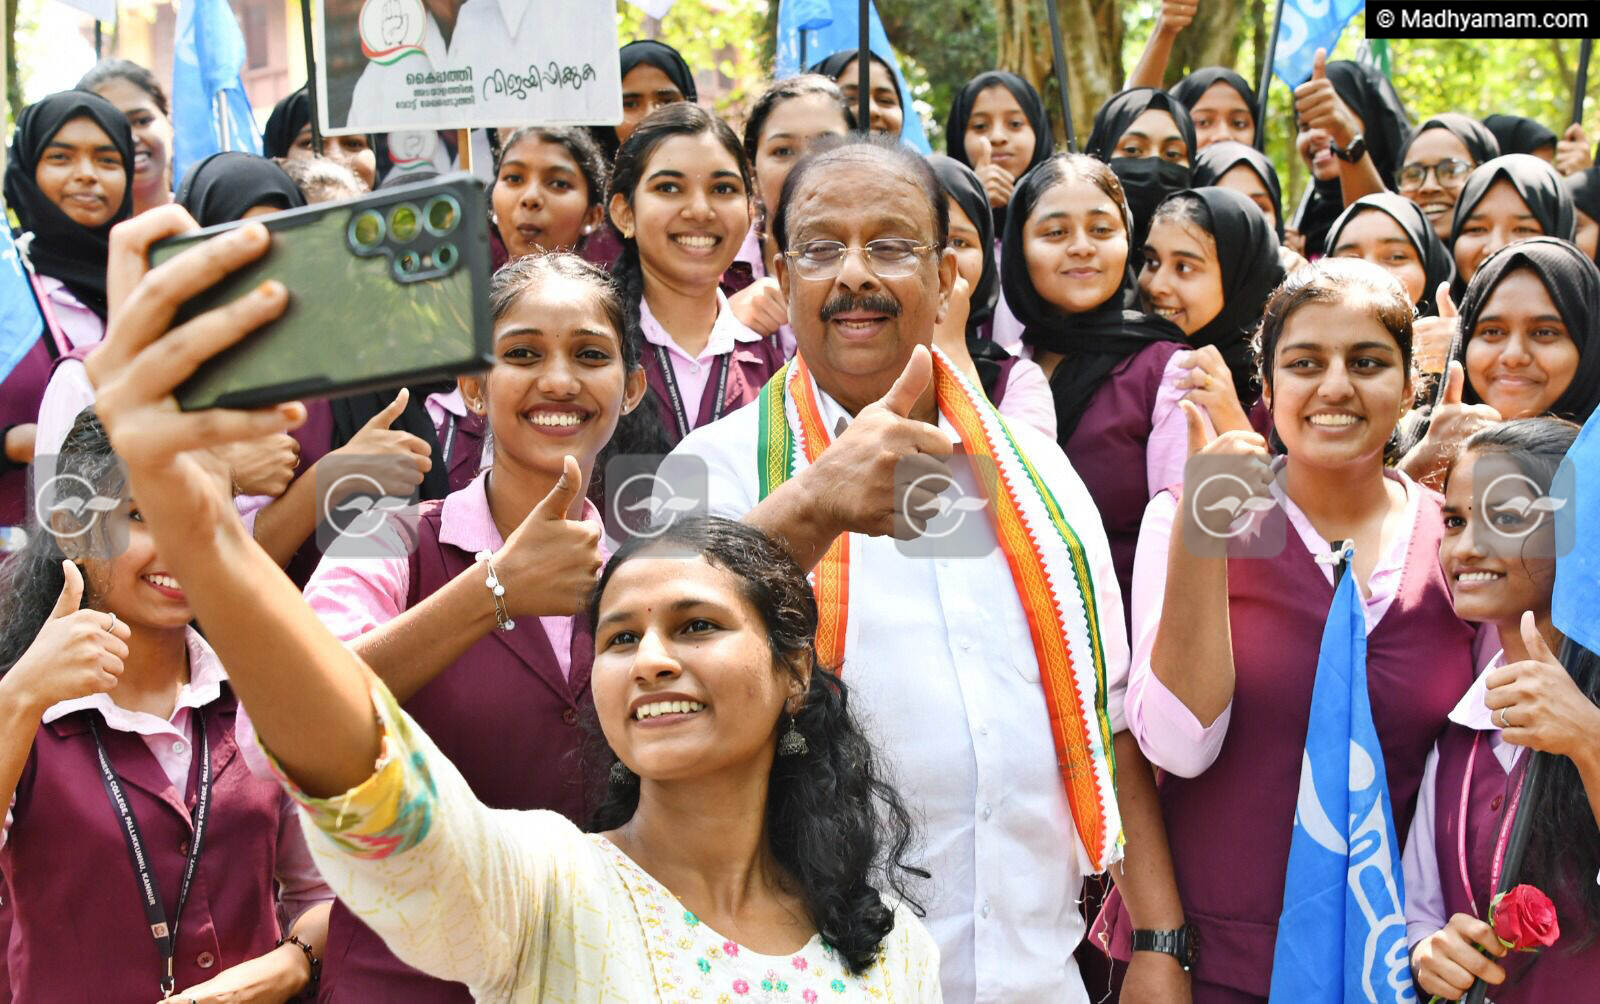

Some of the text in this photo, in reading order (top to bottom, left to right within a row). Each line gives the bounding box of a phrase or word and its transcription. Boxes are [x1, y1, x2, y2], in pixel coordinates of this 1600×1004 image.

[406, 66, 473, 85] കൈപ്പത്തി
[198, 783, 208, 819] COLLEGE,
[110, 780, 129, 817] COLLEGE,
[124, 816, 146, 872] PALLIKKUNNU,
[141, 872, 156, 906] KANNUR
